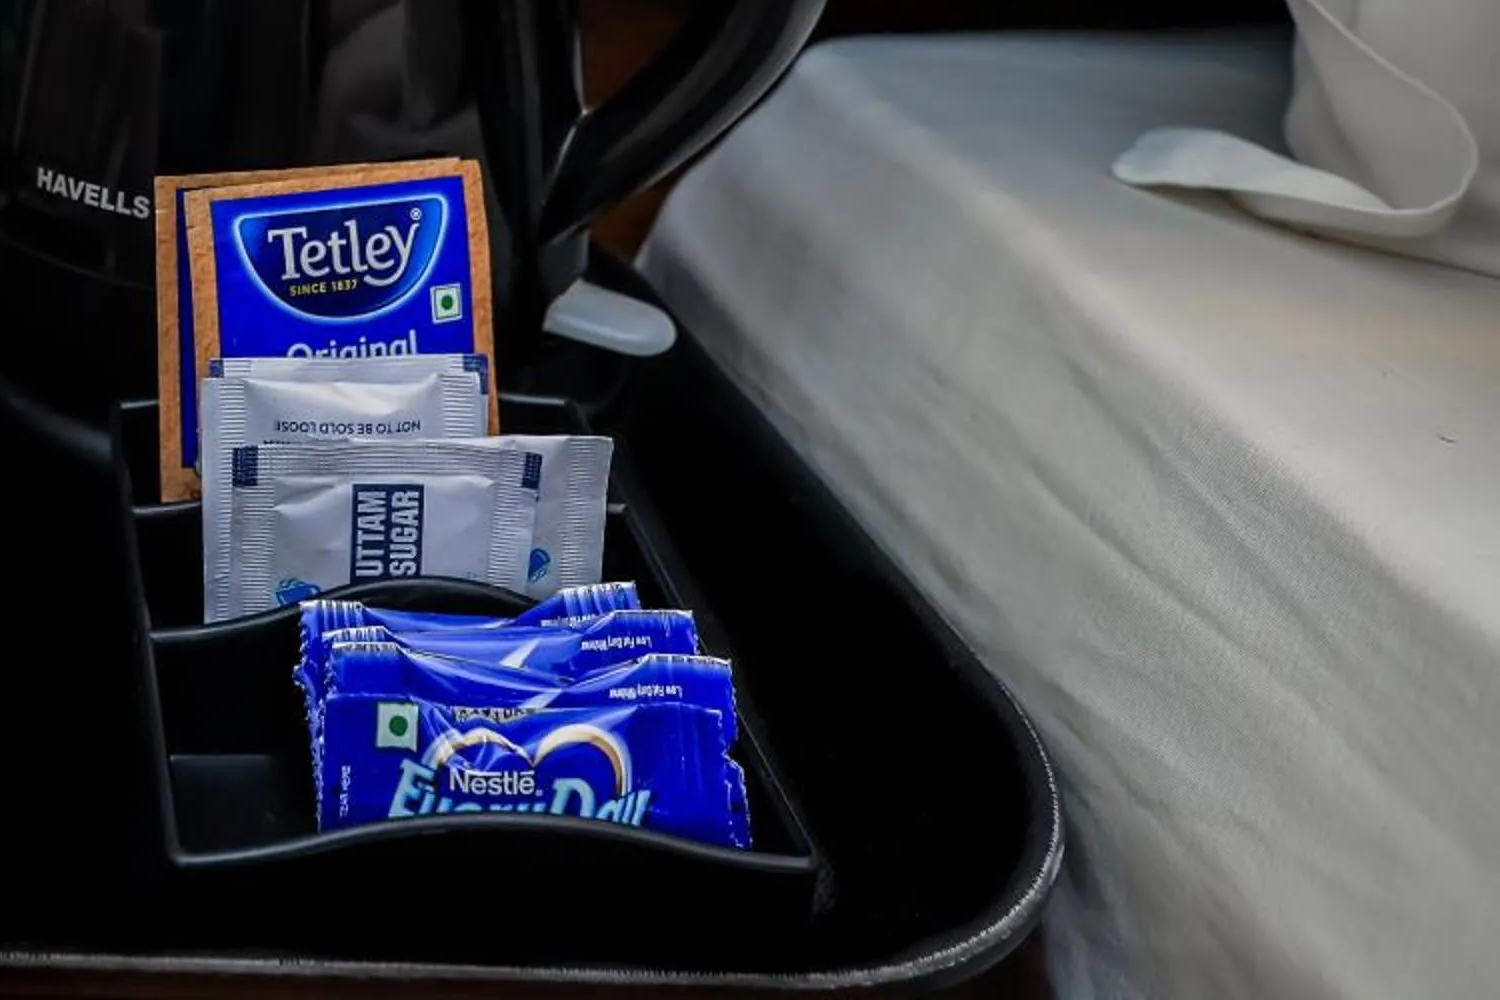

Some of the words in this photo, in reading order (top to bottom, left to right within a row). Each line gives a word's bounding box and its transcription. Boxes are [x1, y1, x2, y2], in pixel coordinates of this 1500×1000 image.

[37, 167, 150, 219] HAVELLS
[267, 219, 420, 286] Tetley
[289, 281, 327, 296] SINCE
[331, 279, 357, 292] 1837
[320, 422, 354, 435] SOLD
[357, 423, 373, 435] BE
[376, 423, 392, 434] TO
[396, 419, 421, 433] NOT
[356, 491, 388, 577] UTTAM
[389, 491, 420, 577] SUGAR
